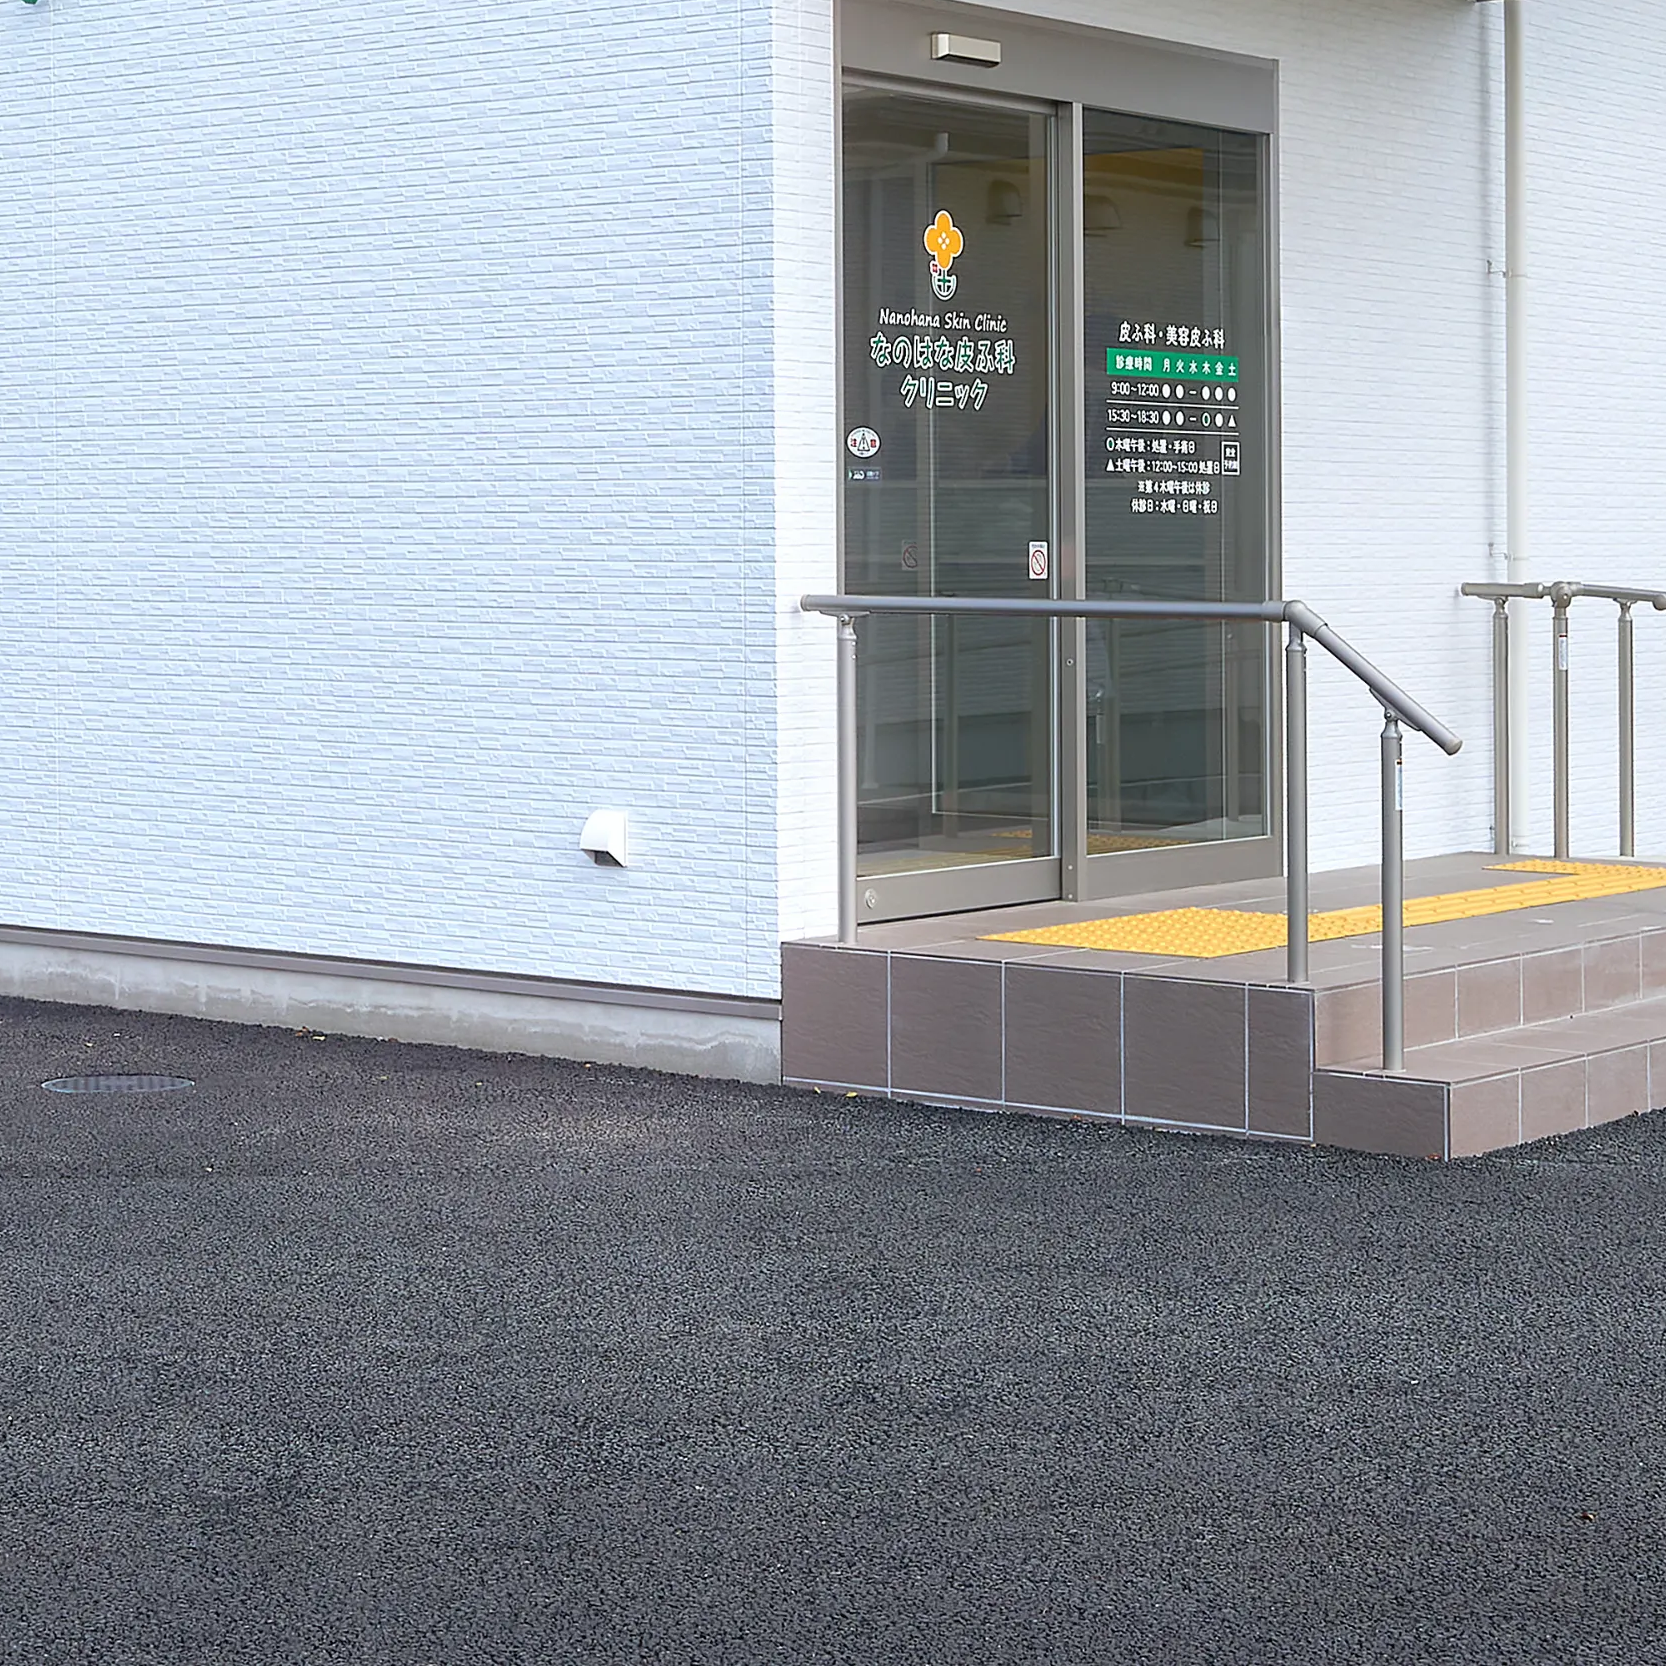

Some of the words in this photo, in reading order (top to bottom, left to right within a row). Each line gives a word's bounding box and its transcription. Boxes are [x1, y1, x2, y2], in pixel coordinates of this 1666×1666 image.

[879, 308, 940, 328] Nanohana
[944, 311, 971, 330] Skin
[974, 314, 1007, 332] Clinic
[1119, 320, 1226, 350] 皮ふ科・美容皮ふ科
[870, 331, 1016, 374] なのはな皮ふ科
[1115, 354, 1153, 372] 診療時間
[1162, 357, 1171, 373] 月
[1176, 358, 1185, 374] 火
[1188, 359, 1198, 375] 水
[1201, 360, 1211, 375] 木
[1214, 361, 1224, 376] 金
[1227, 362, 1237, 376] 土
[900, 374, 989, 411] クリニック
